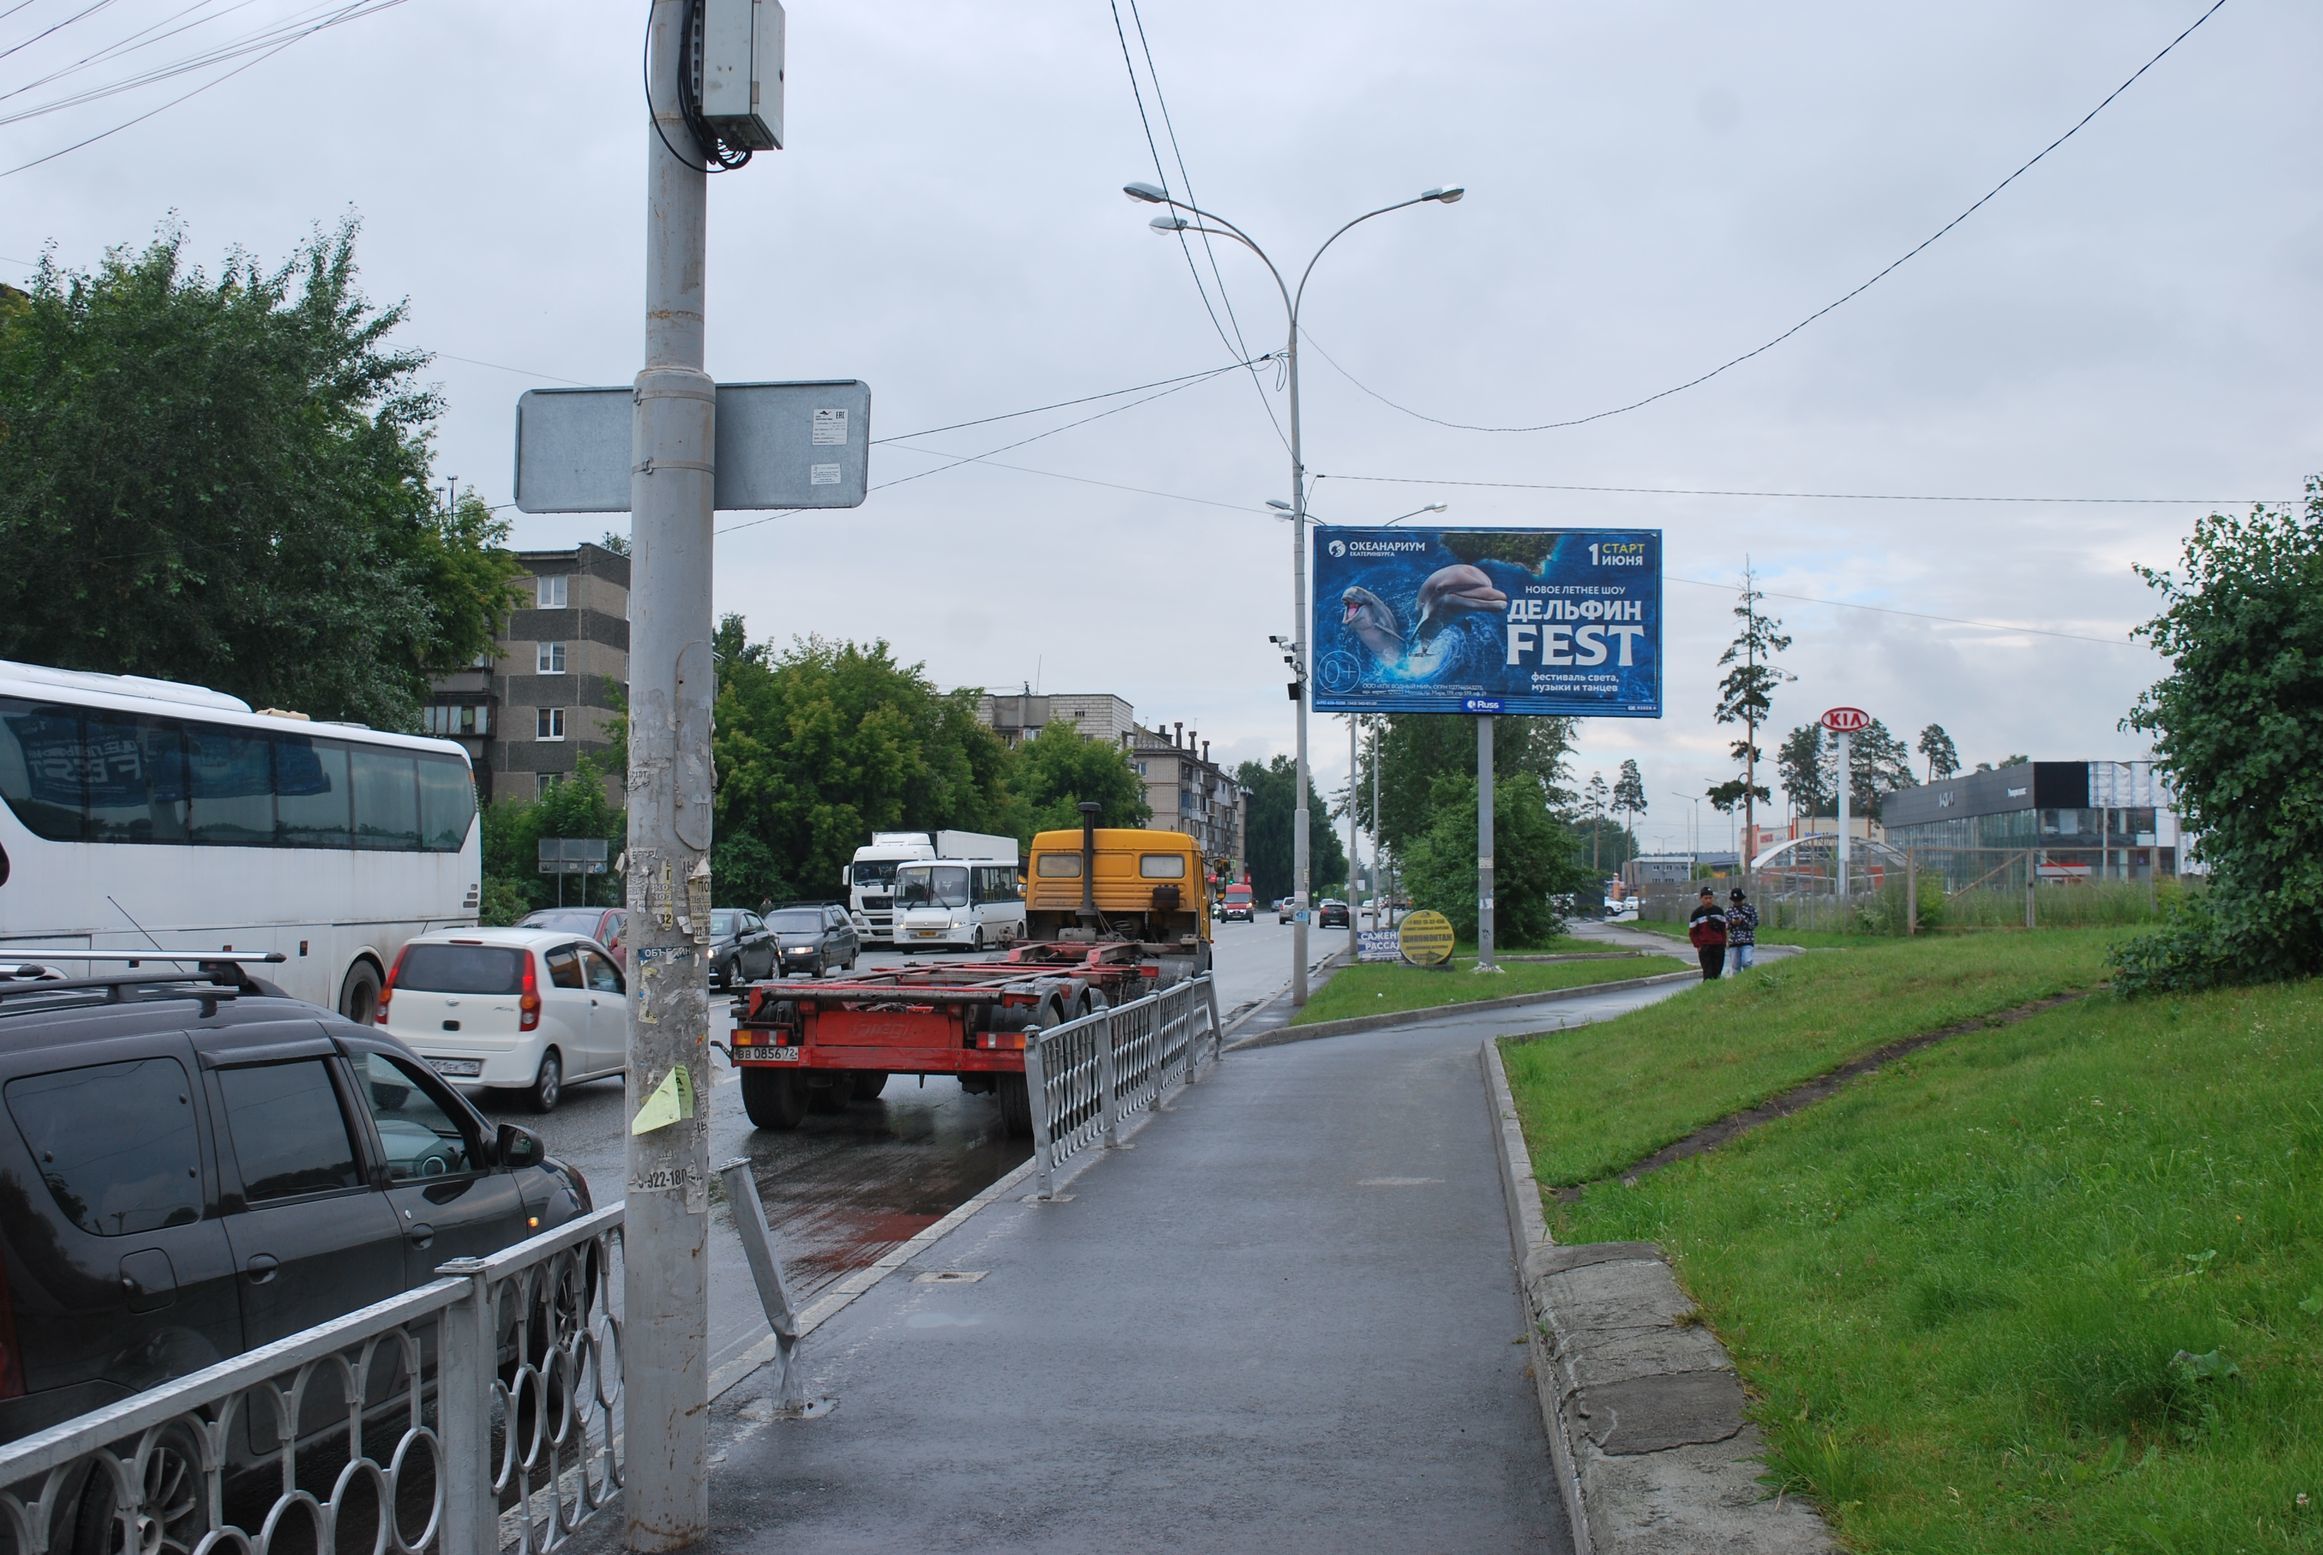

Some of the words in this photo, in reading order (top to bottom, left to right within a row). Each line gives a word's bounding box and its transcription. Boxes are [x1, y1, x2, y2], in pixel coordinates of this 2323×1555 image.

[1349, 541, 1426, 552] ОКЕАНАРИУМ
[1602, 543, 1646, 554] СТАРТ
[1588, 543, 1599, 566] 1
[1602, 555, 1644, 566] ИЮНЯ
[1525, 585, 1561, 594] НОВОЕ
[1562, 586, 1600, 595] ЛЕТНЕЕ
[1601, 586, 1626, 595] ШОУ
[1507, 599, 1642, 623] ДЕЛЬФИН
[1506, 624, 1645, 667] FEST
[1324, 659, 1358, 684] 0+
[1530, 672, 1587, 683] фестиваль
[1587, 674, 1620, 683] света,
[1531, 684, 1572, 693] музыки
[1581, 684, 1619, 693] танцев
[1477, 700, 1500, 709] Russ
[1829, 712, 1862, 727] KIA
[1360, 931, 1399, 941] САЖЕН
[754, 1048, 781, 1059] 0856
